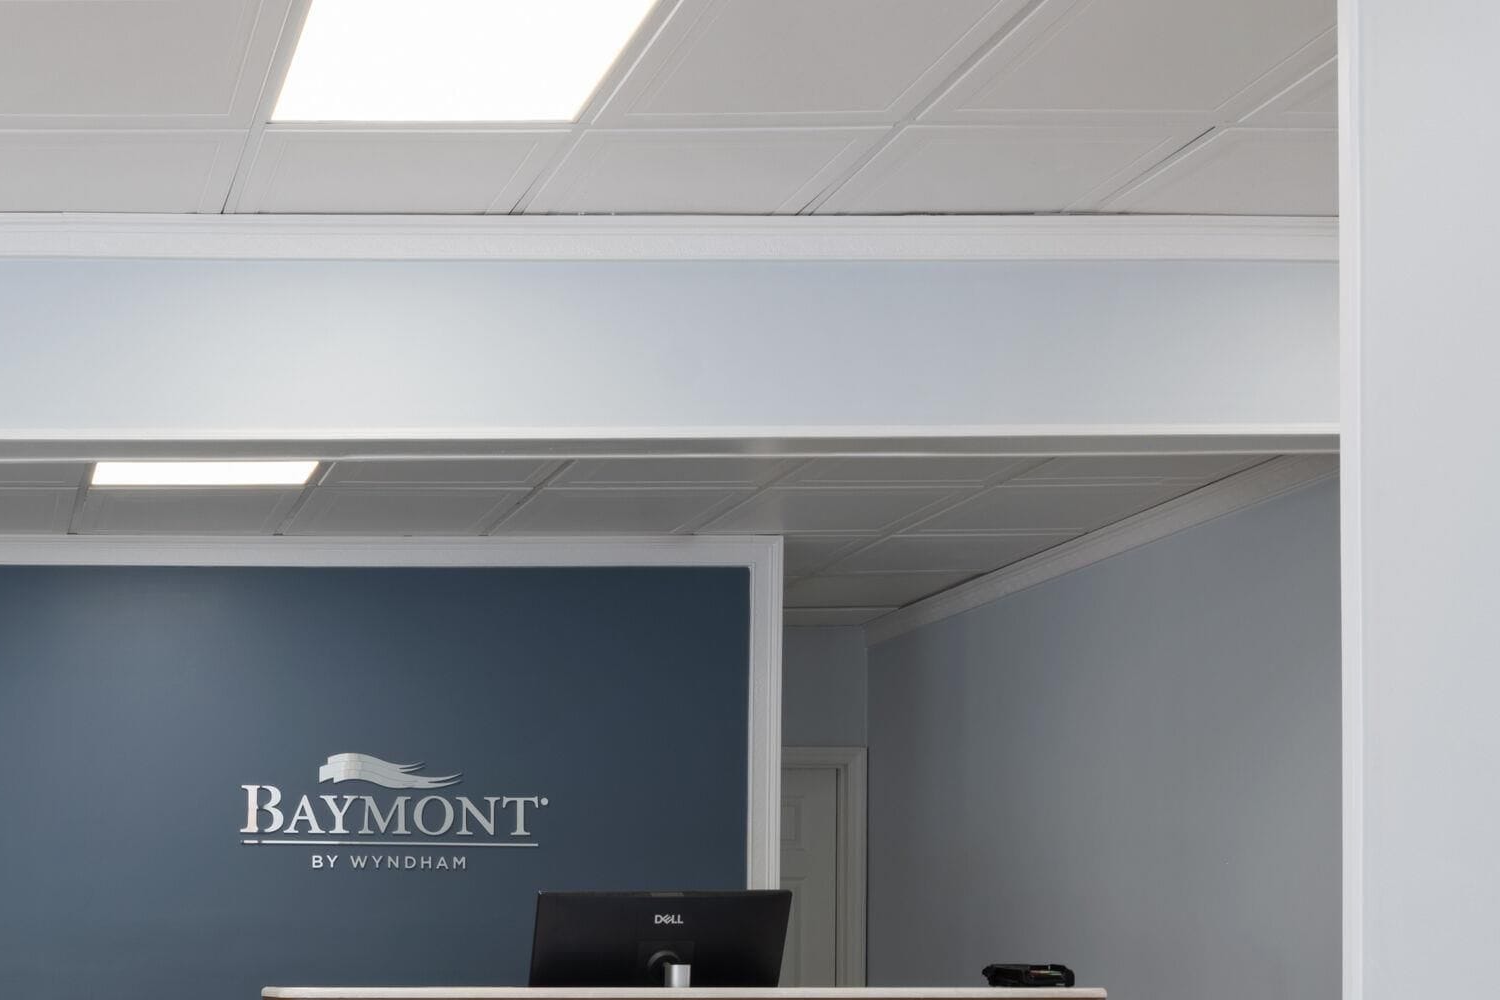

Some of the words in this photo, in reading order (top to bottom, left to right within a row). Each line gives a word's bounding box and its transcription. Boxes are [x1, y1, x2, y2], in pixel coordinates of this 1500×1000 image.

[240, 785, 540, 835] BAYMONT
[311, 855, 339, 869] BY
[350, 855, 468, 870] WYNDHAM
[654, 914, 684, 925] DELL
